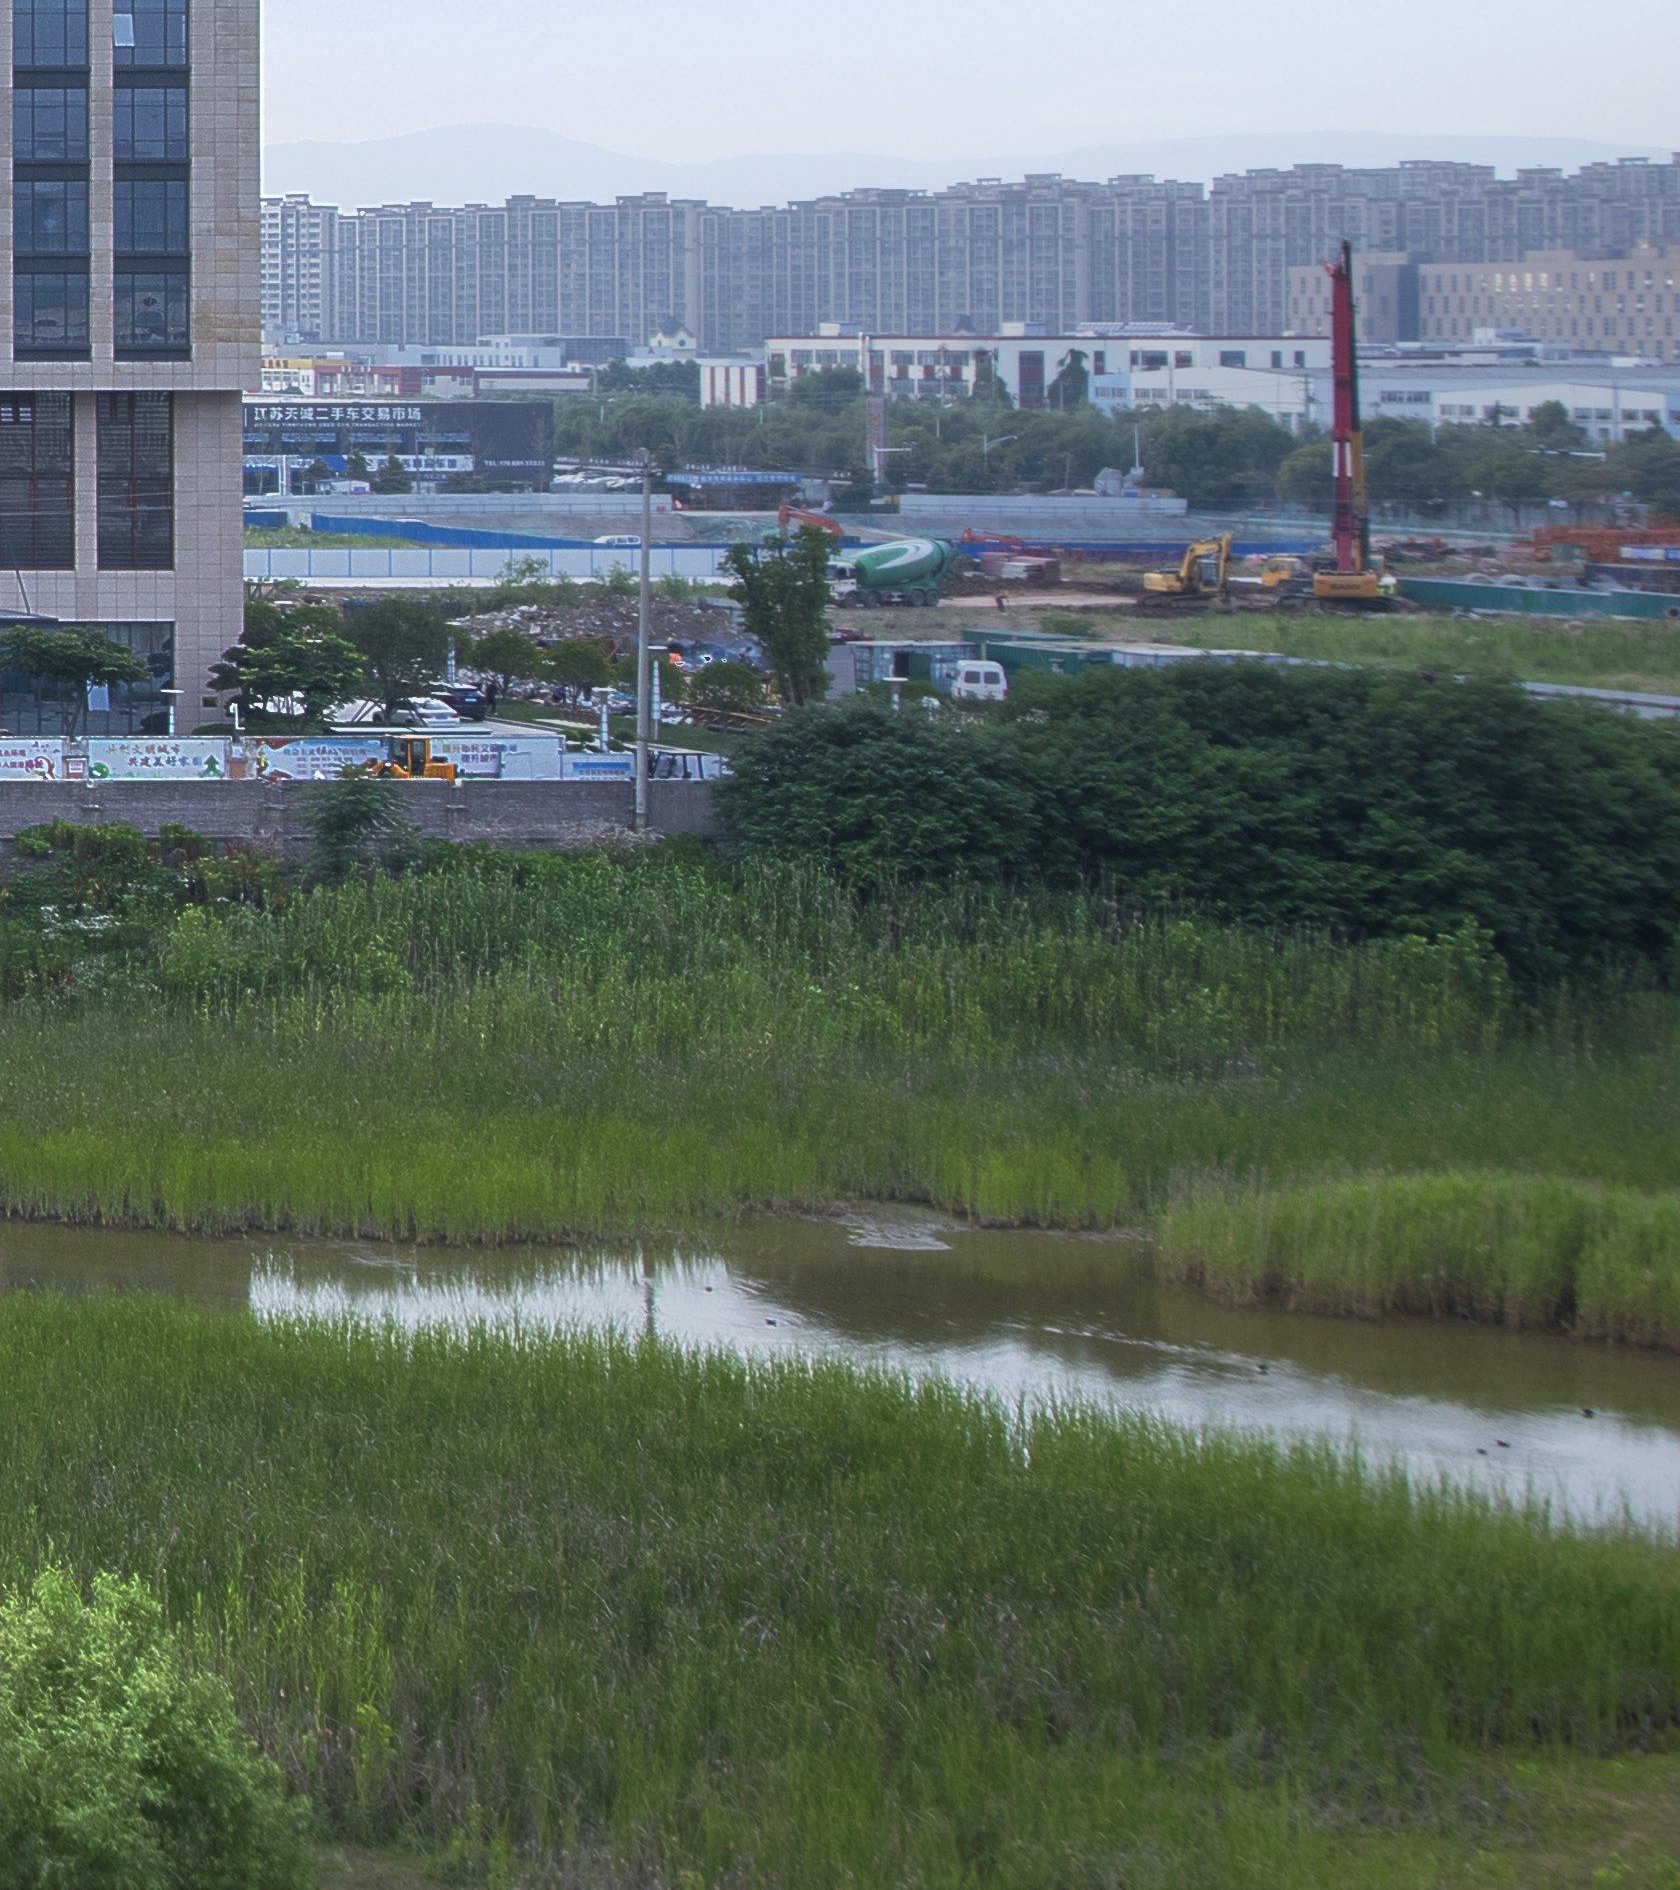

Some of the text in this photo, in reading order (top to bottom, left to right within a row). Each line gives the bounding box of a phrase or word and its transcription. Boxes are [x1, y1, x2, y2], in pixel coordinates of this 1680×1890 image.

[254, 407, 422, 421] 江苏天诚二手车交易市场
